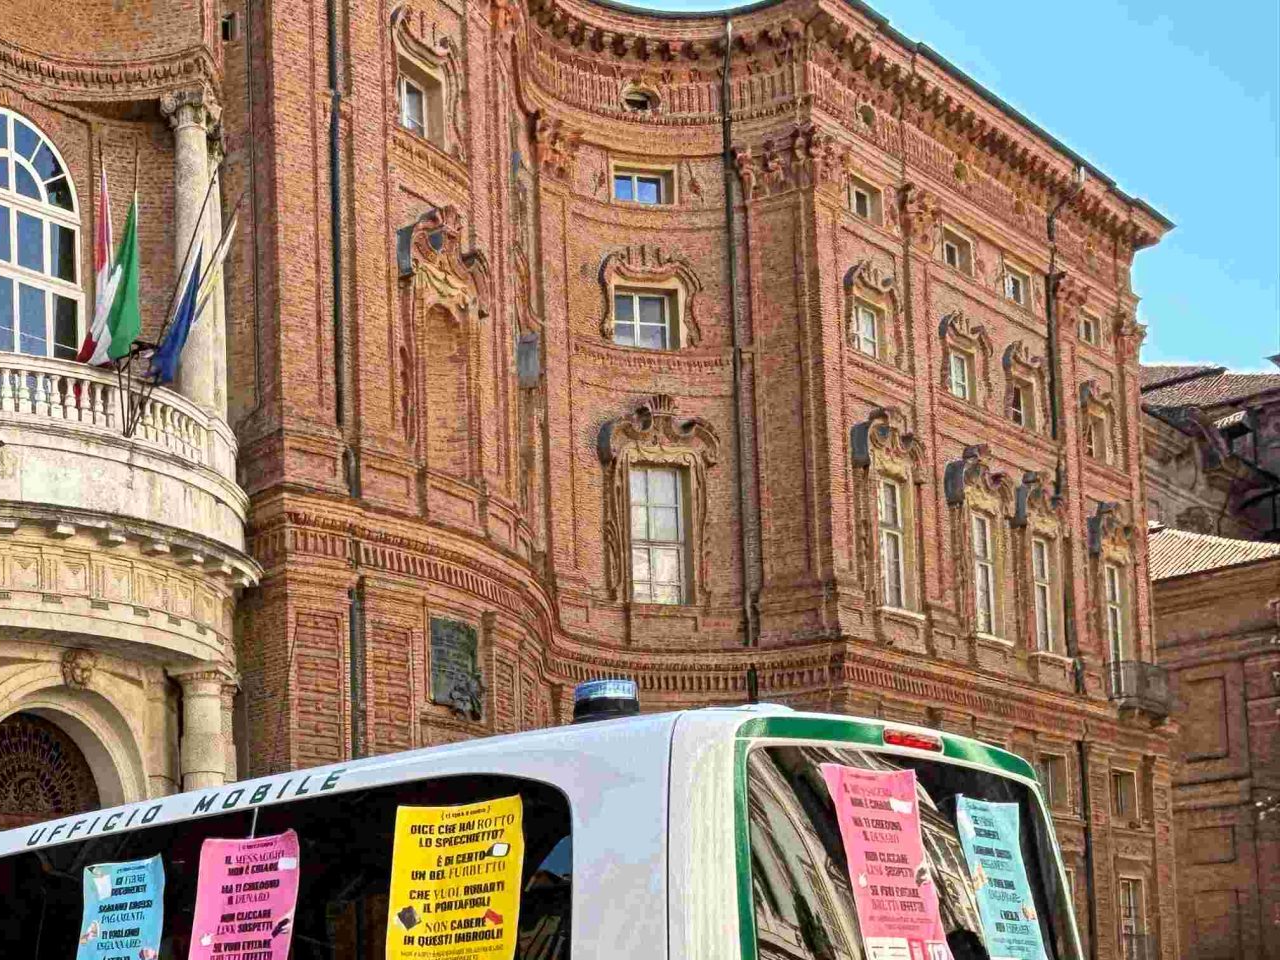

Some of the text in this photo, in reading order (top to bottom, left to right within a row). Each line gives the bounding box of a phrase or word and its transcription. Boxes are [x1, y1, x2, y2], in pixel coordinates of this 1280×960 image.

[26, 768, 347, 847] UFFICIO MOBILE
[410, 813, 515, 835] DICE CHE HAI ROTTO
[419, 828, 505, 848] LO SPECCHIETTO?
[445, 855, 455, 866] DI
[456, 850, 487, 864] CERTO
[411, 870, 426, 881] UN
[409, 889, 430, 901] CHE
[423, 902, 432, 913] IL
[424, 916, 487, 935] NON CADERE
[403, 935, 415, 946] IN
[417, 932, 452, 948] QUESTI
